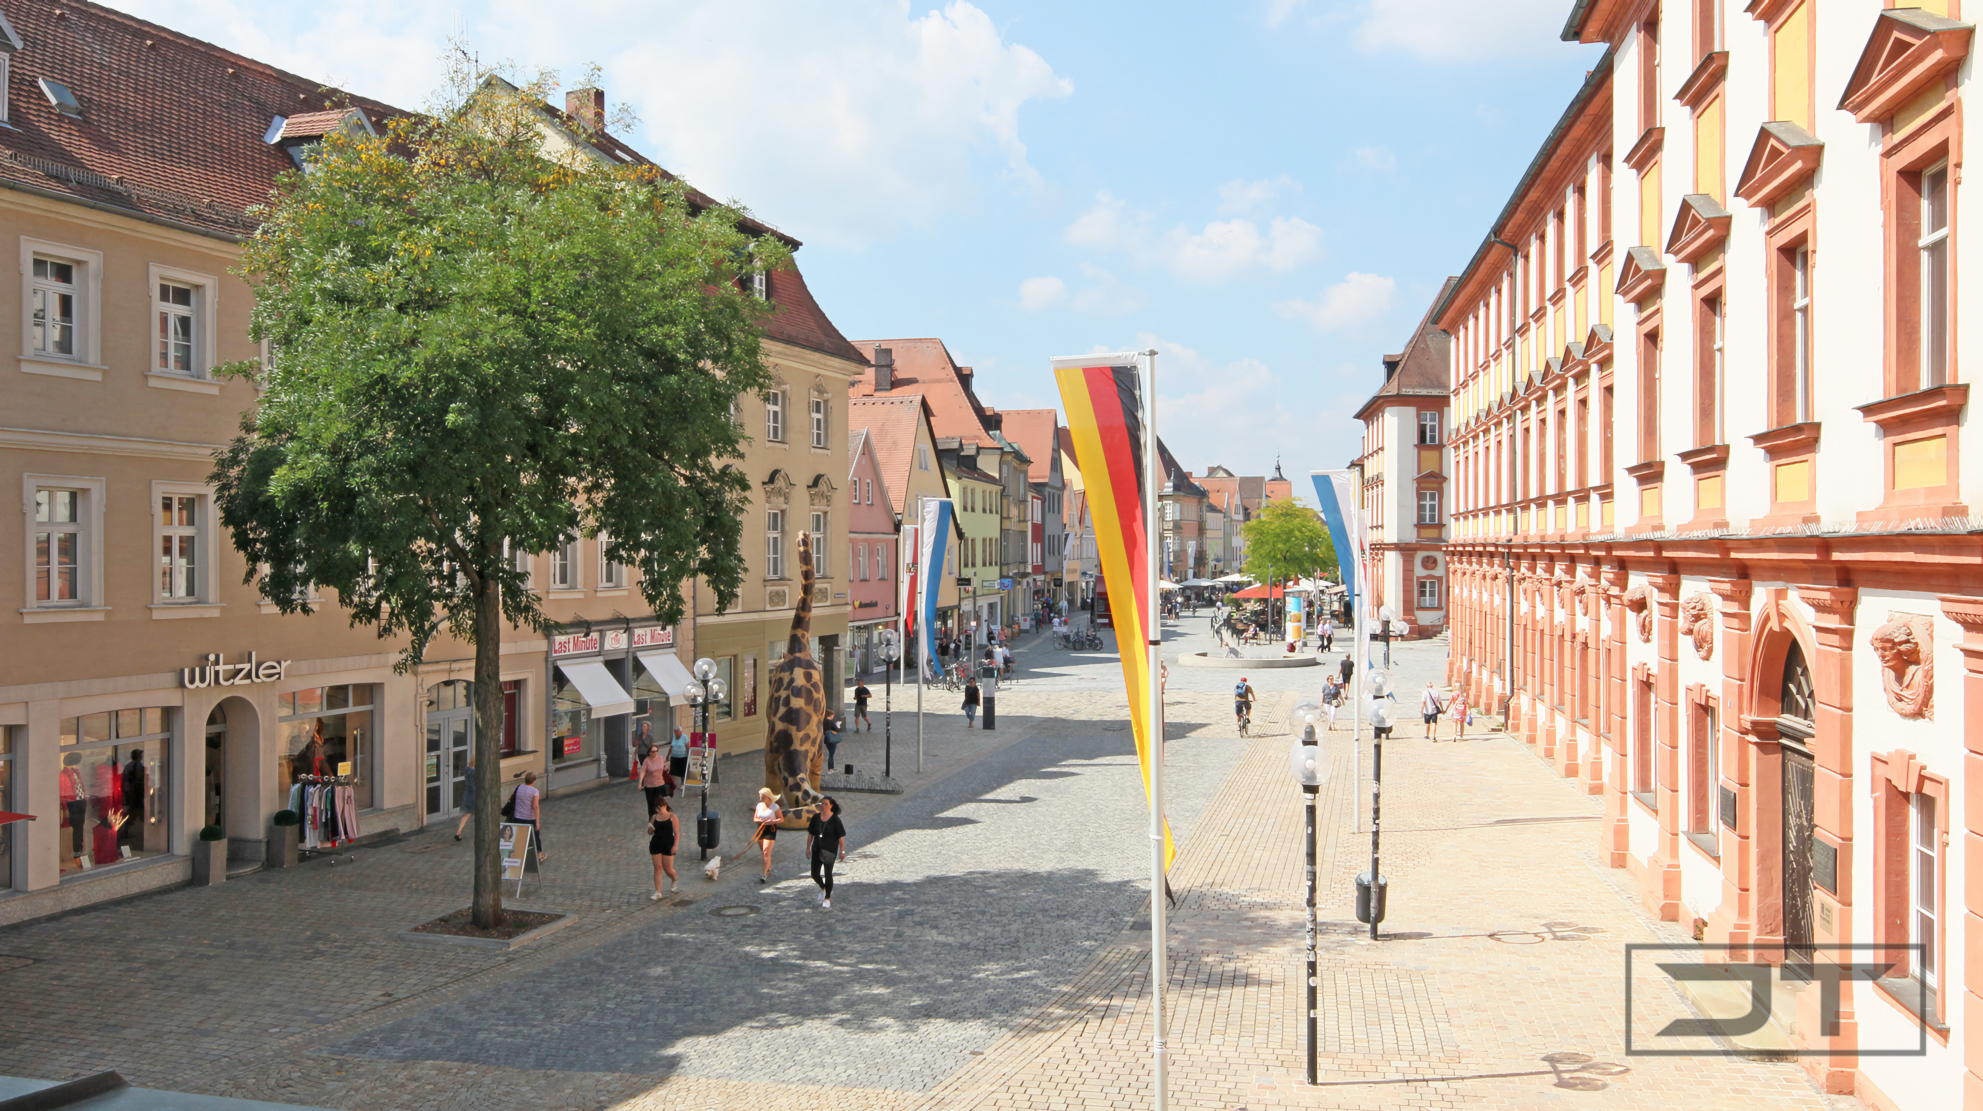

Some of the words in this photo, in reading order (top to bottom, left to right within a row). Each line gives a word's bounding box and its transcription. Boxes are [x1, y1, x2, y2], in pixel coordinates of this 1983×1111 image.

[553, 638, 571, 654] Last
[572, 635, 598, 652] Minute
[633, 629, 647, 645] Last
[184, 651, 292, 689] witzler
